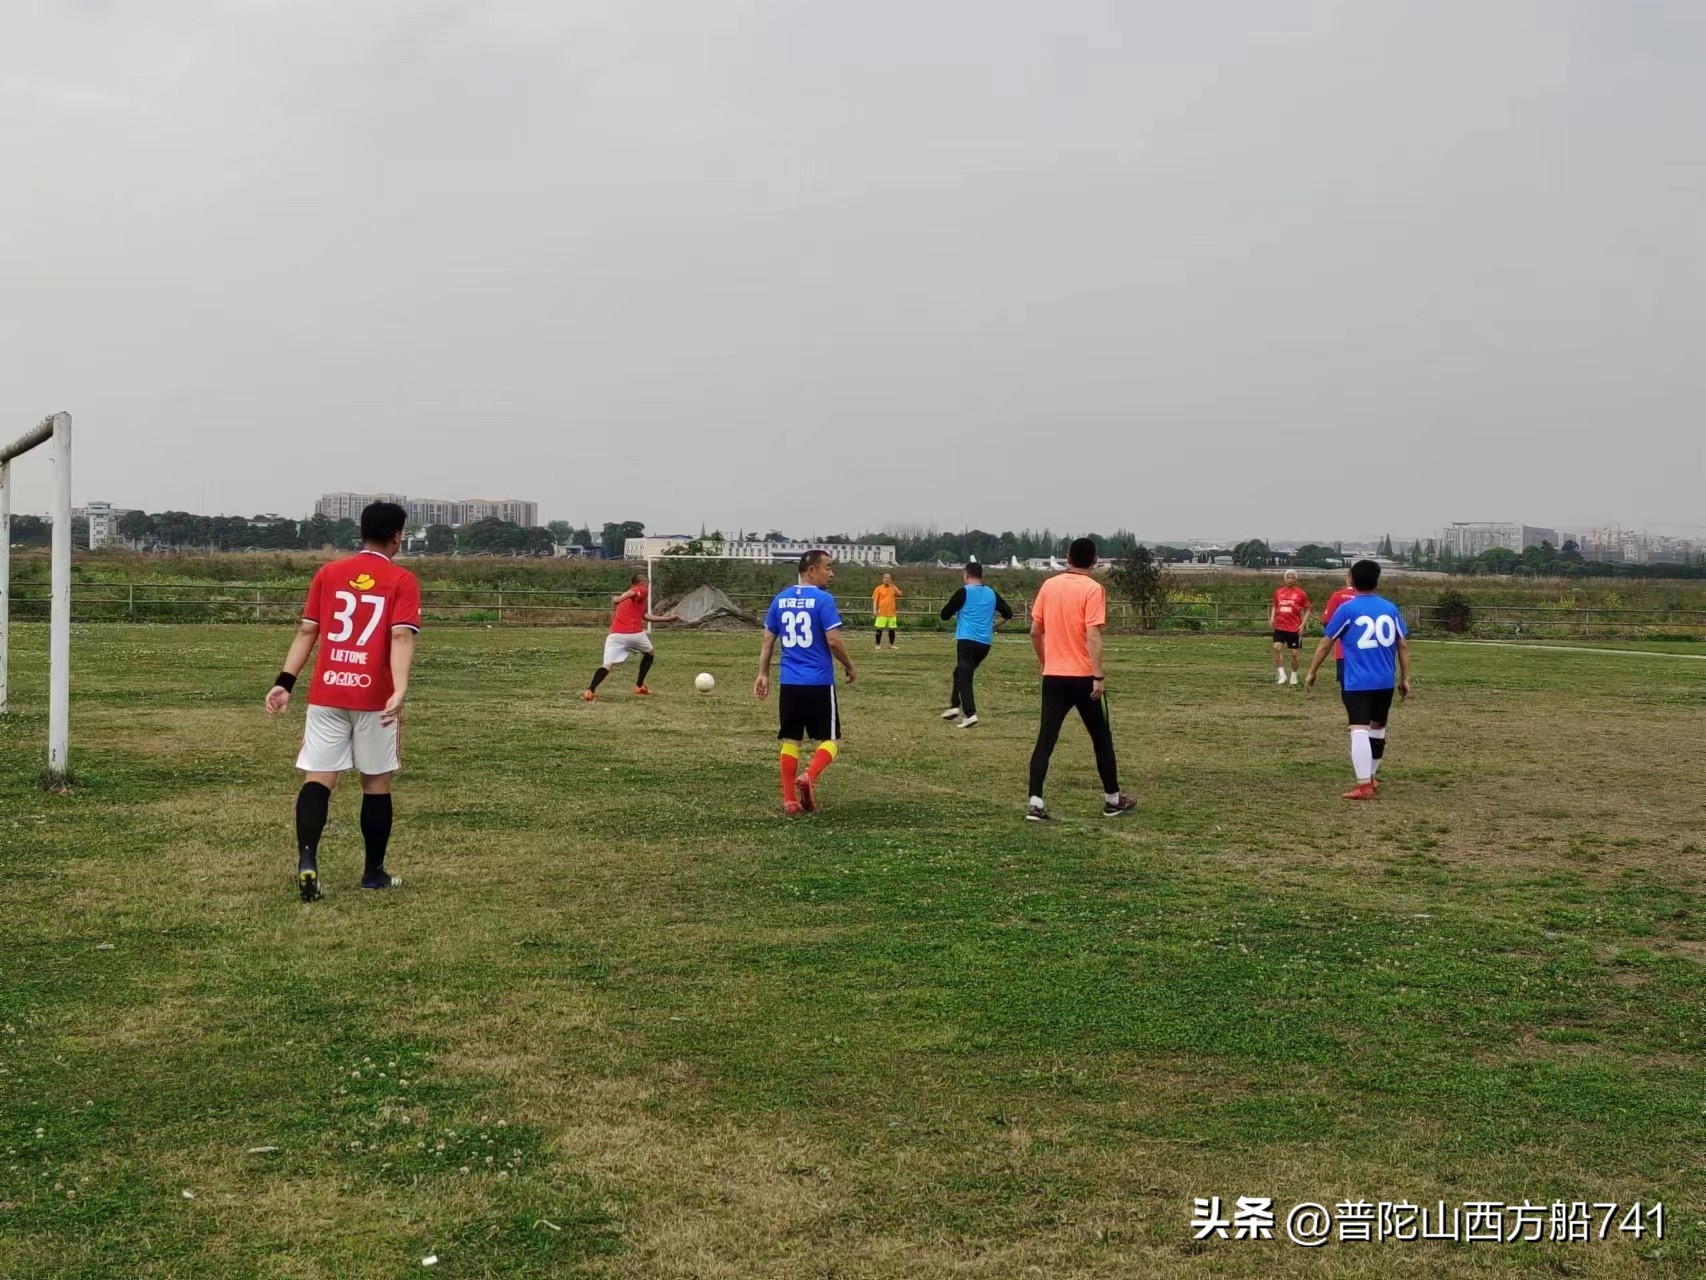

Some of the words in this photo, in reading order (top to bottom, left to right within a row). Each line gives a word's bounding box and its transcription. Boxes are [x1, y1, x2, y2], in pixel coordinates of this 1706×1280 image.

[327, 590, 386, 646] 37
[781, 611, 813, 648] 33
[1355, 614, 1396, 650] 20
